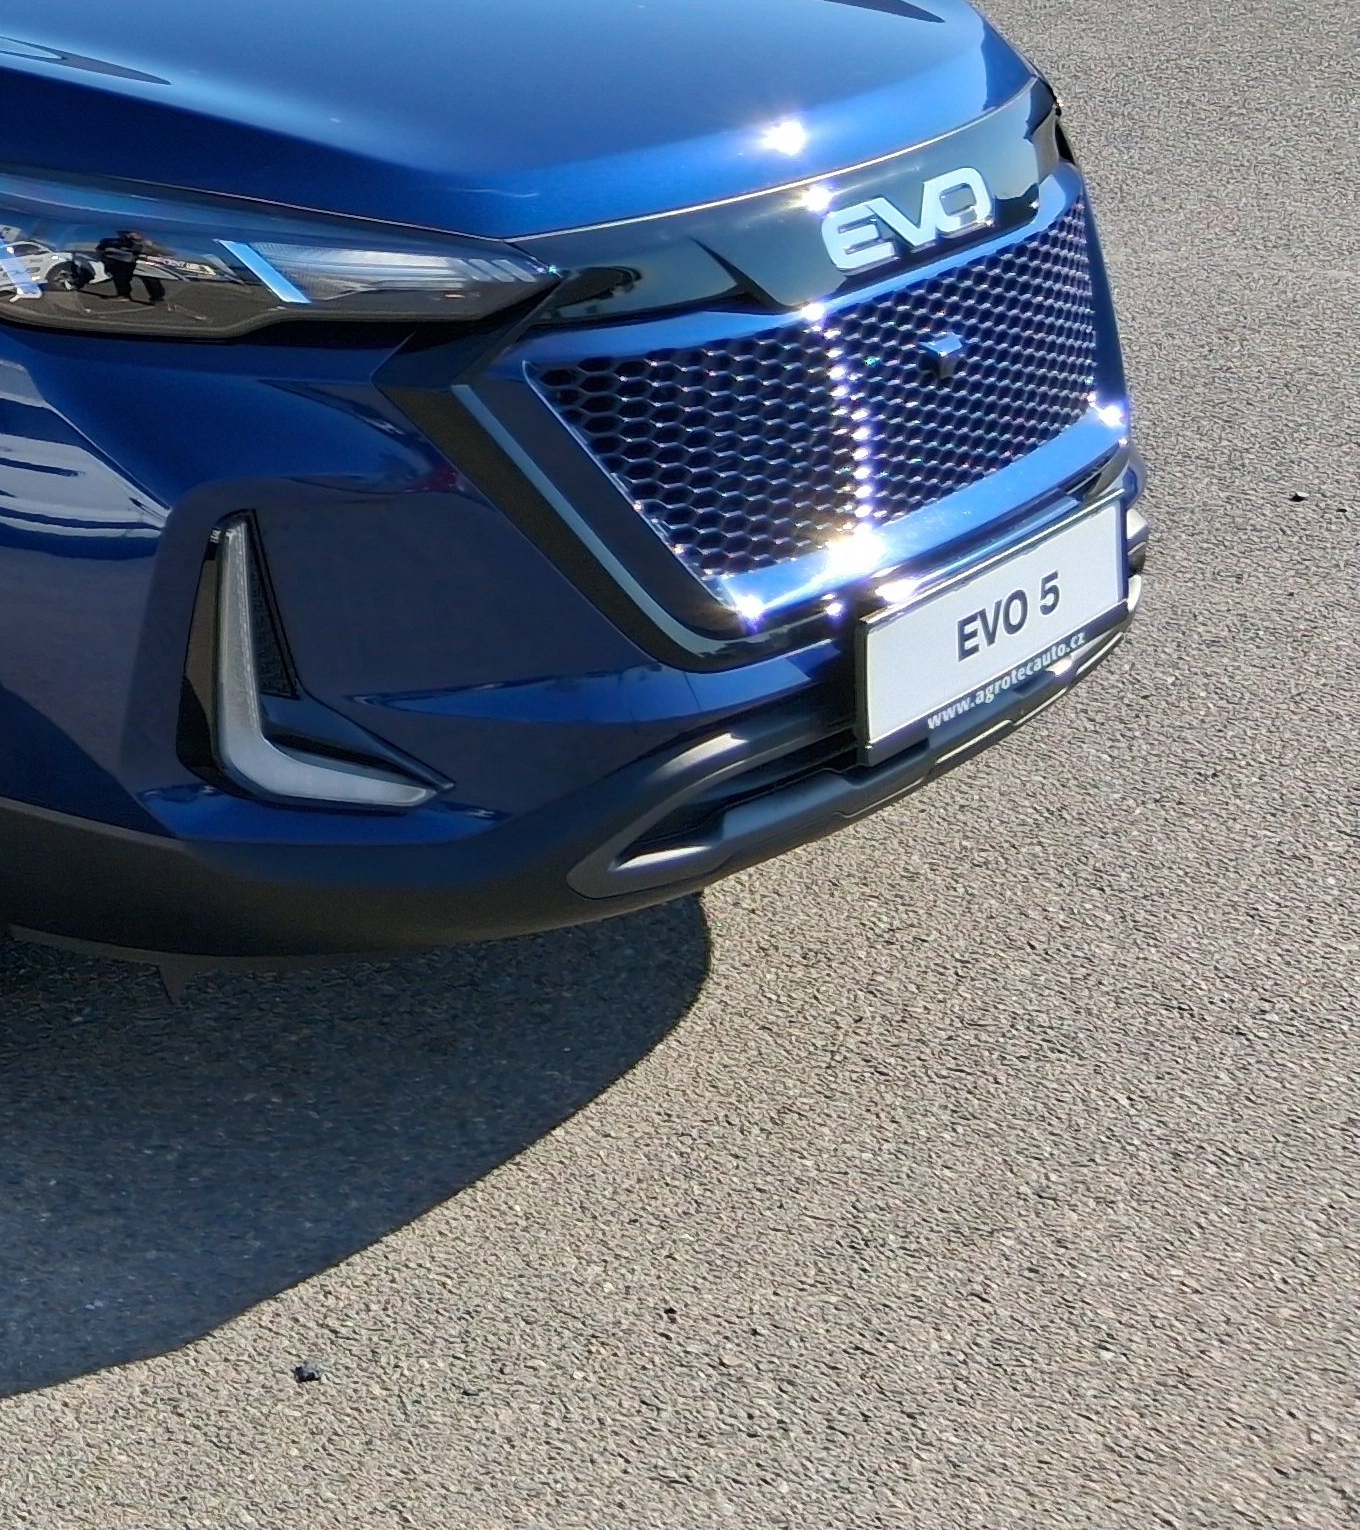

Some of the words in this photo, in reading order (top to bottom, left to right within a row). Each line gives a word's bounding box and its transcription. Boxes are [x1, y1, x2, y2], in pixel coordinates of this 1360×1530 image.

[821, 167, 994, 276] EVO
[957, 588, 1028, 662] EVO
[1039, 570, 1060, 616] 5
[926, 631, 1087, 730] www.agrotecauto.cz
